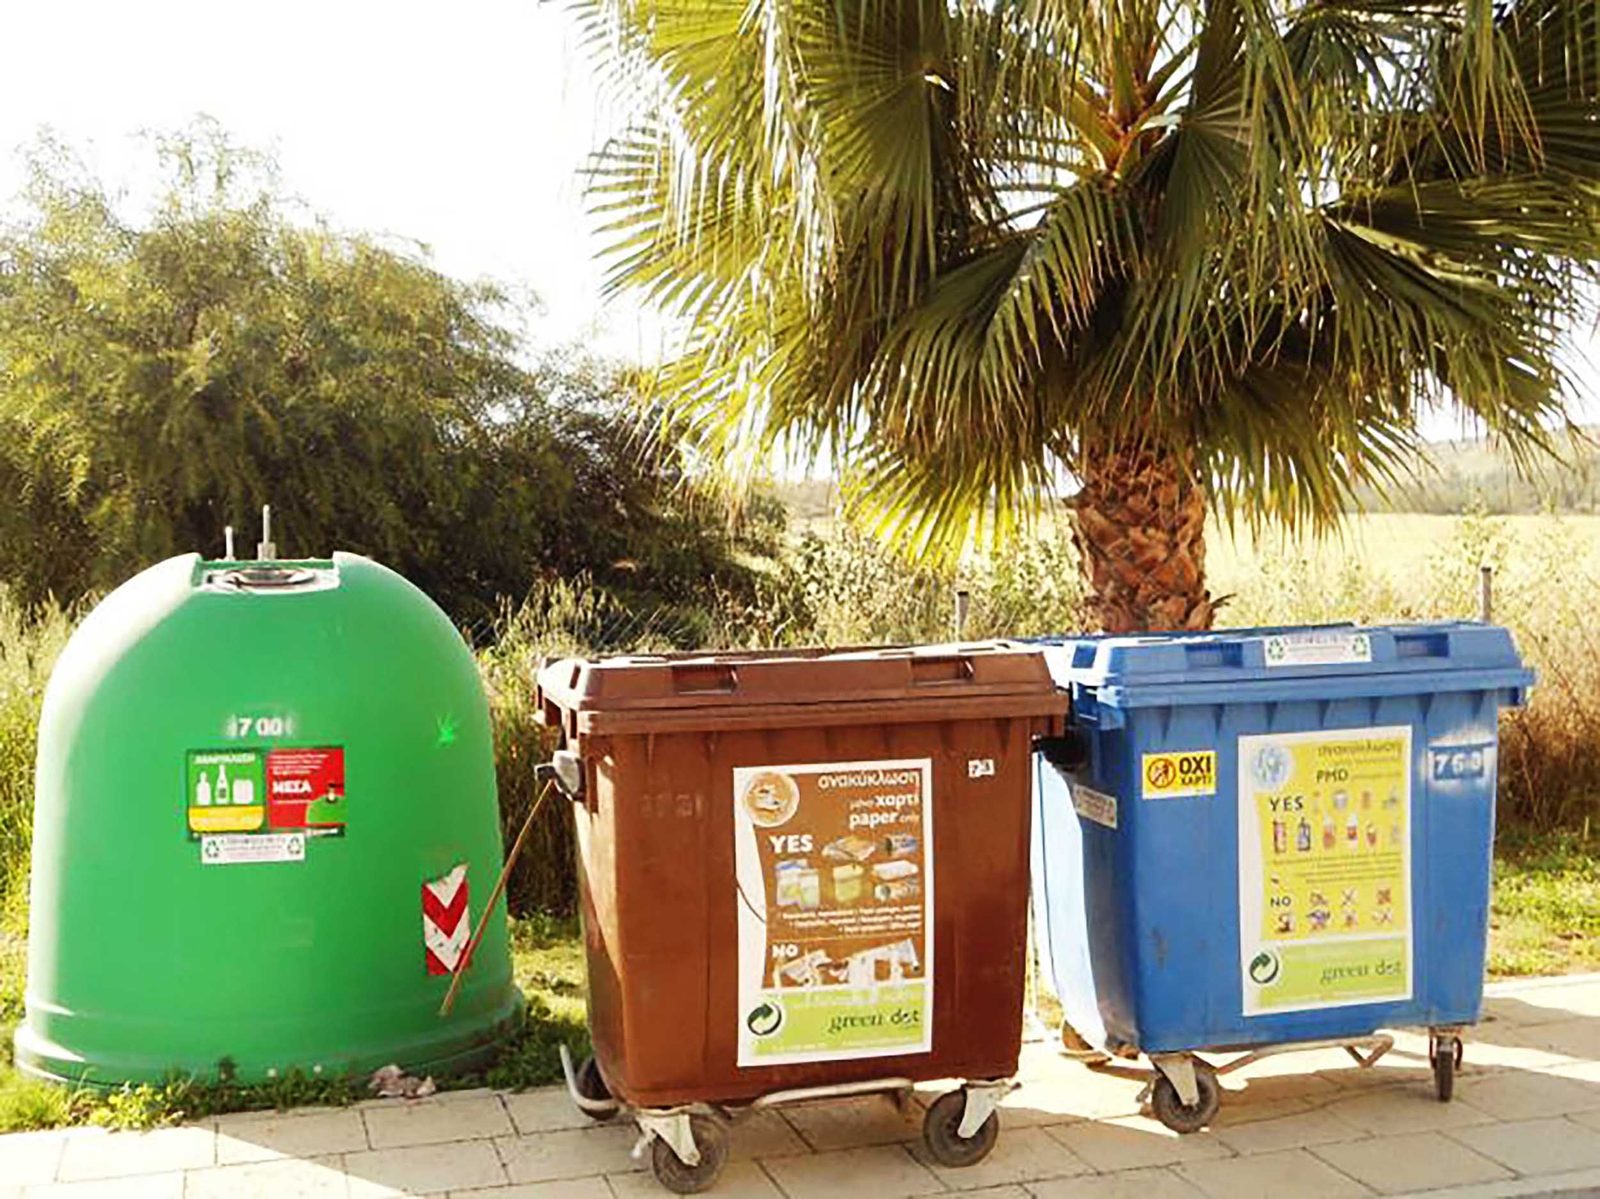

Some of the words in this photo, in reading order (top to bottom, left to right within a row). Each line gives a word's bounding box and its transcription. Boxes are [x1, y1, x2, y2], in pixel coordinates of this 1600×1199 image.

[1269, 795, 1304, 812] YES
[848, 812, 898, 831] paper
[769, 833, 814, 853] YES
[1270, 895, 1292, 908] NO
[772, 943, 798, 958] NO
[1320, 963, 1369, 985] green
[828, 1012, 884, 1034] green
[889, 1008, 920, 1025] dot
